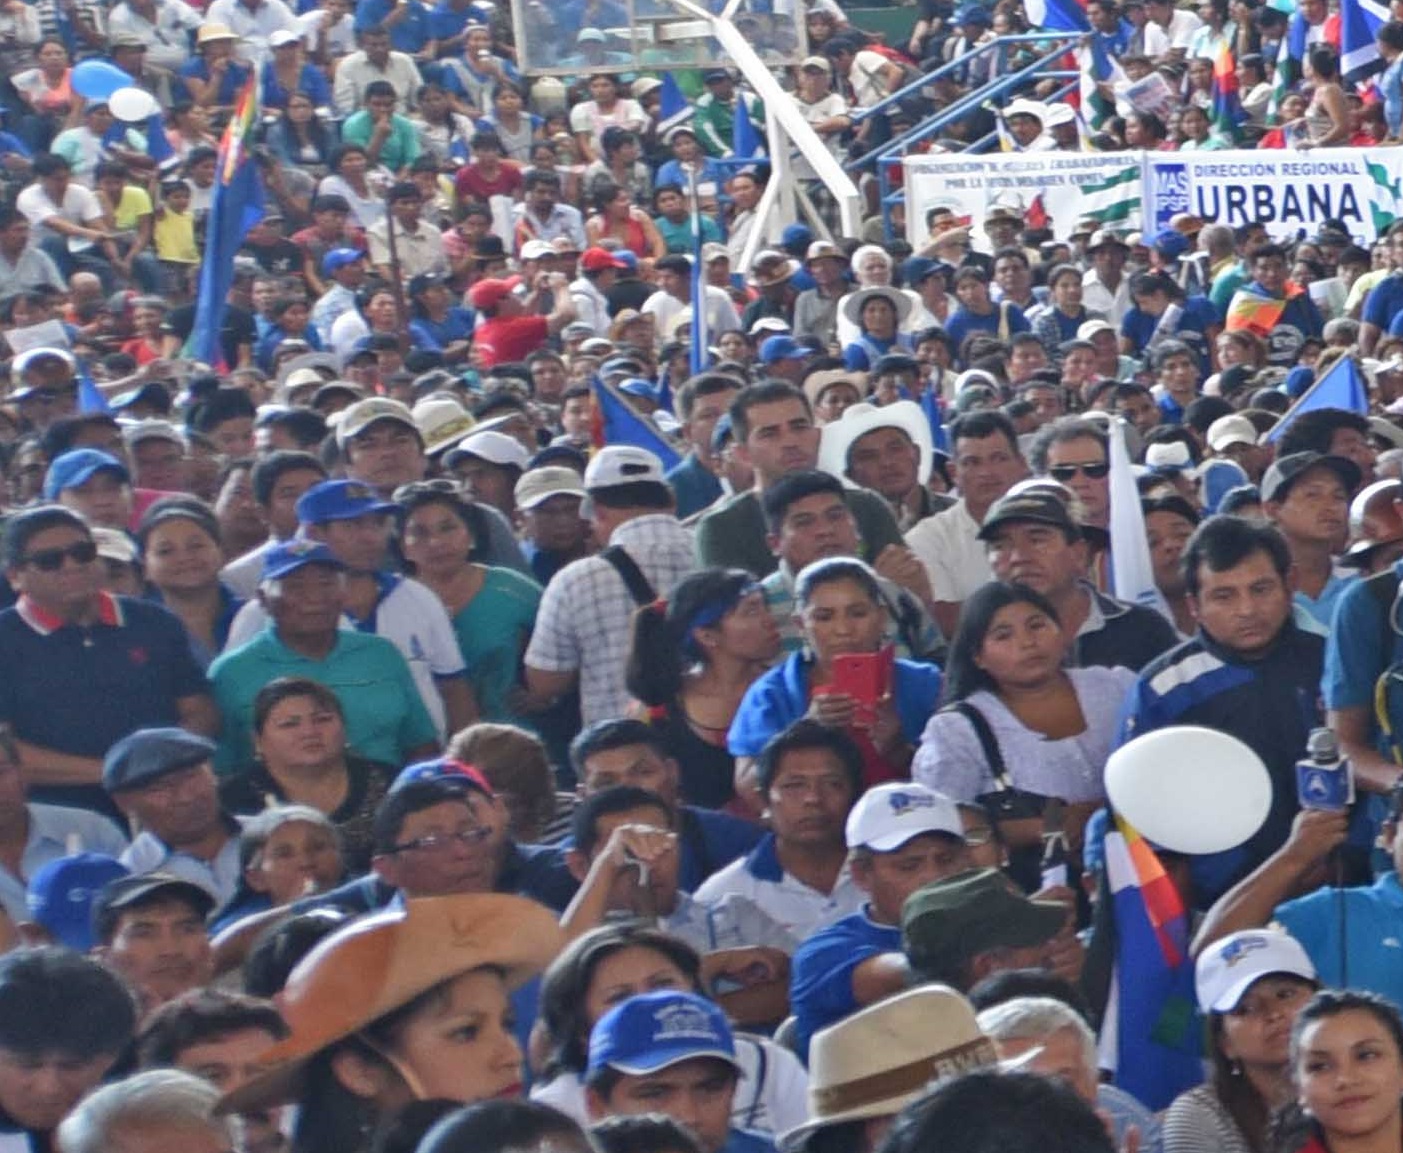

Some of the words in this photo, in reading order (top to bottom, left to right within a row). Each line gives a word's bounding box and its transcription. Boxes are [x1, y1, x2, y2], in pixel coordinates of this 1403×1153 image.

[1281, 161, 1360, 176] REGIONAL
[1156, 171, 1189, 191] MAS
[1196, 183, 1364, 224] URBANA
